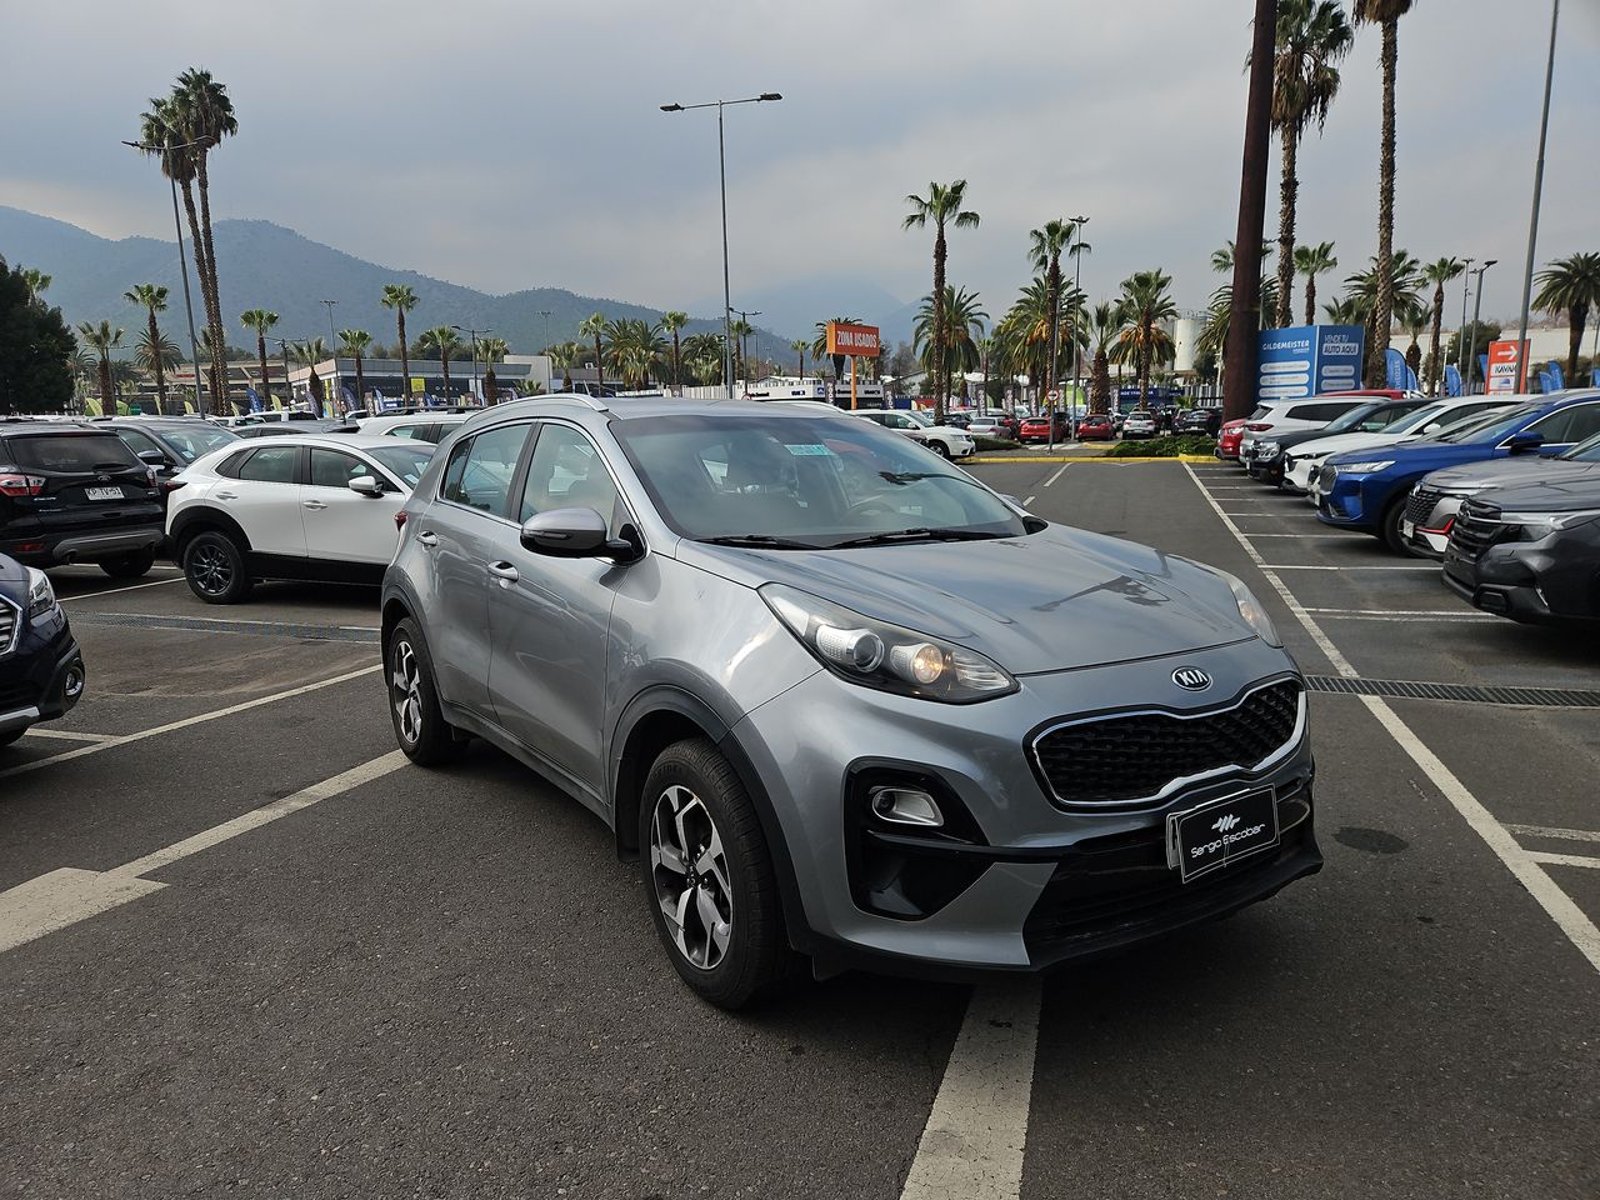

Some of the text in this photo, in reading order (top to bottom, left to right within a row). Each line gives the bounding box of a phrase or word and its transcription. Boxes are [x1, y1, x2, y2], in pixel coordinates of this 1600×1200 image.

[837, 331, 877, 348] ZONA USADOS
[1262, 340, 1310, 350] GILDEMEISTER
[1324, 345, 1341, 354] AUTO
[1177, 669, 1208, 686] KIA
[1222, 823, 1266, 845] Escobar
